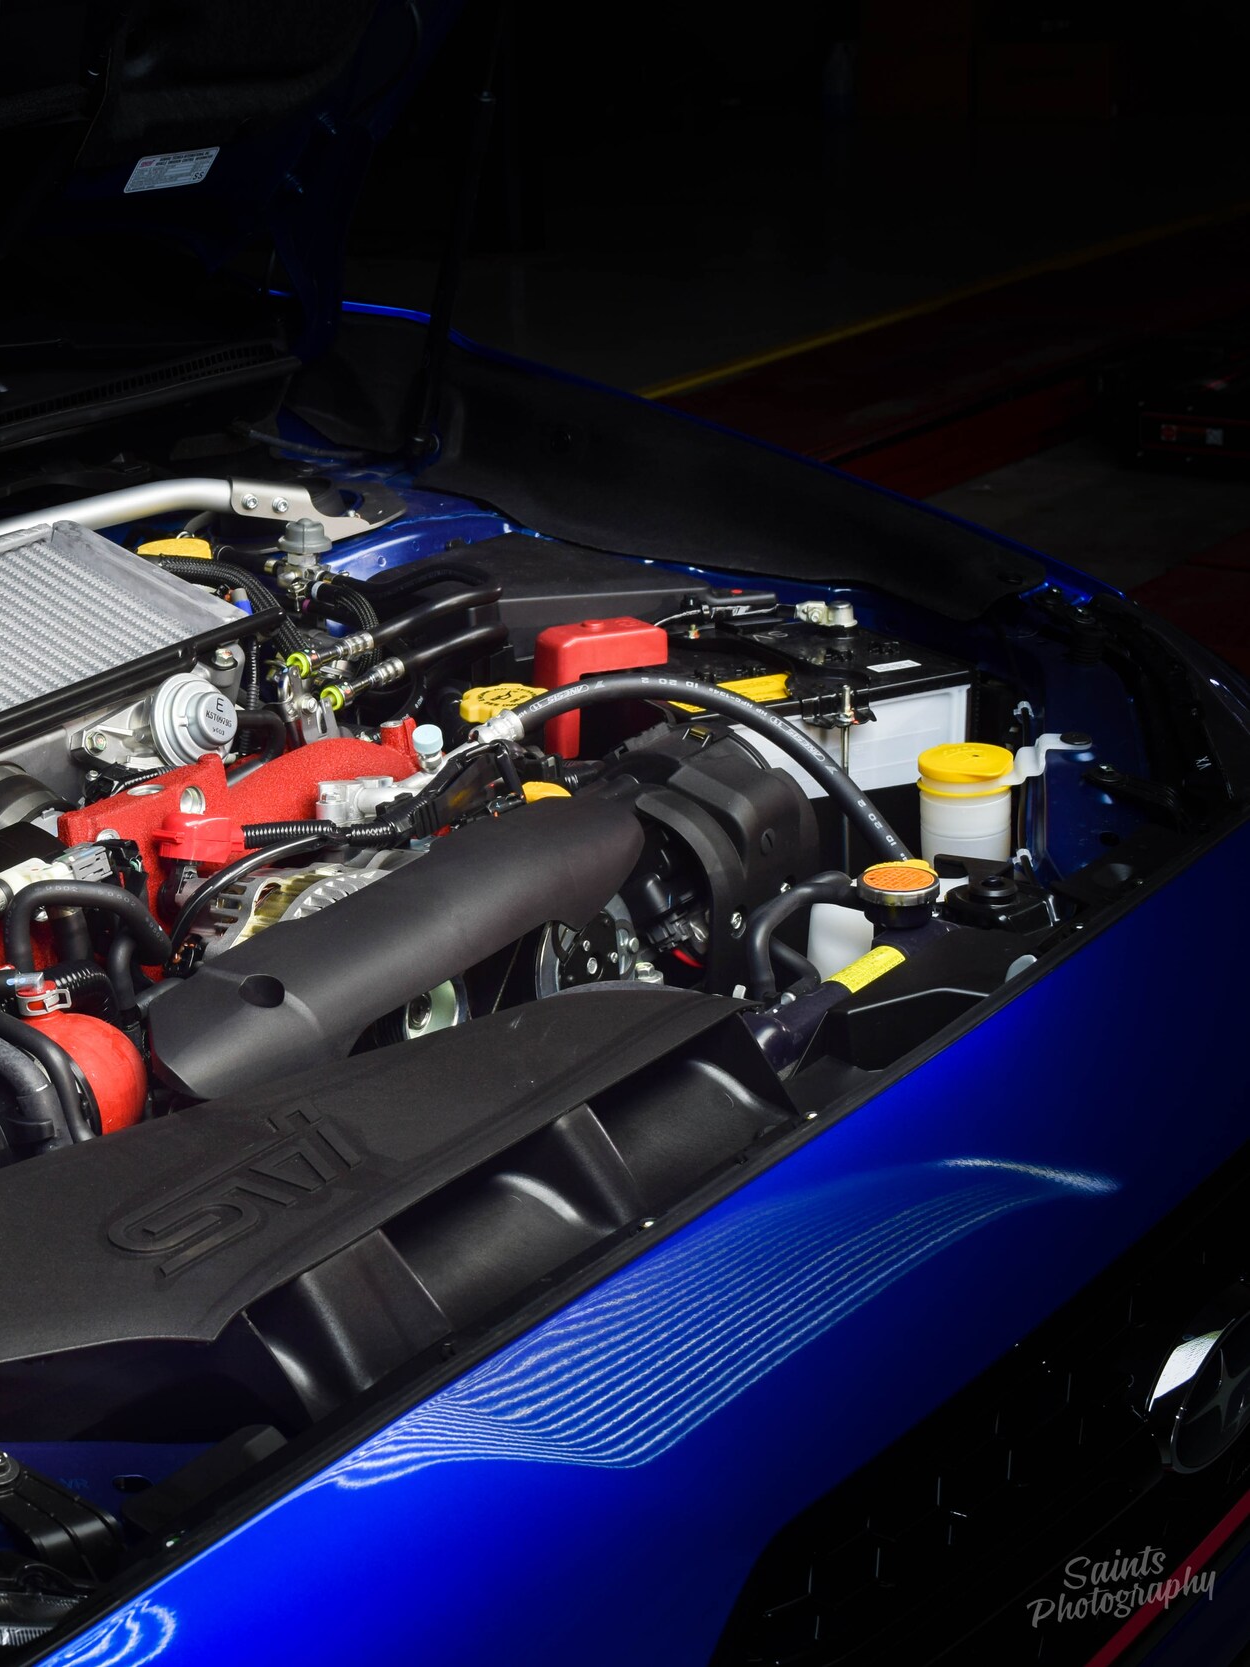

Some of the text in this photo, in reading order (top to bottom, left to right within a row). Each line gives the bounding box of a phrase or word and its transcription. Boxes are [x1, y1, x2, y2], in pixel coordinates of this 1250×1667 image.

[658, 678, 678, 687] 20
[215, 697, 225, 713] E
[868, 812, 884, 830] 20
